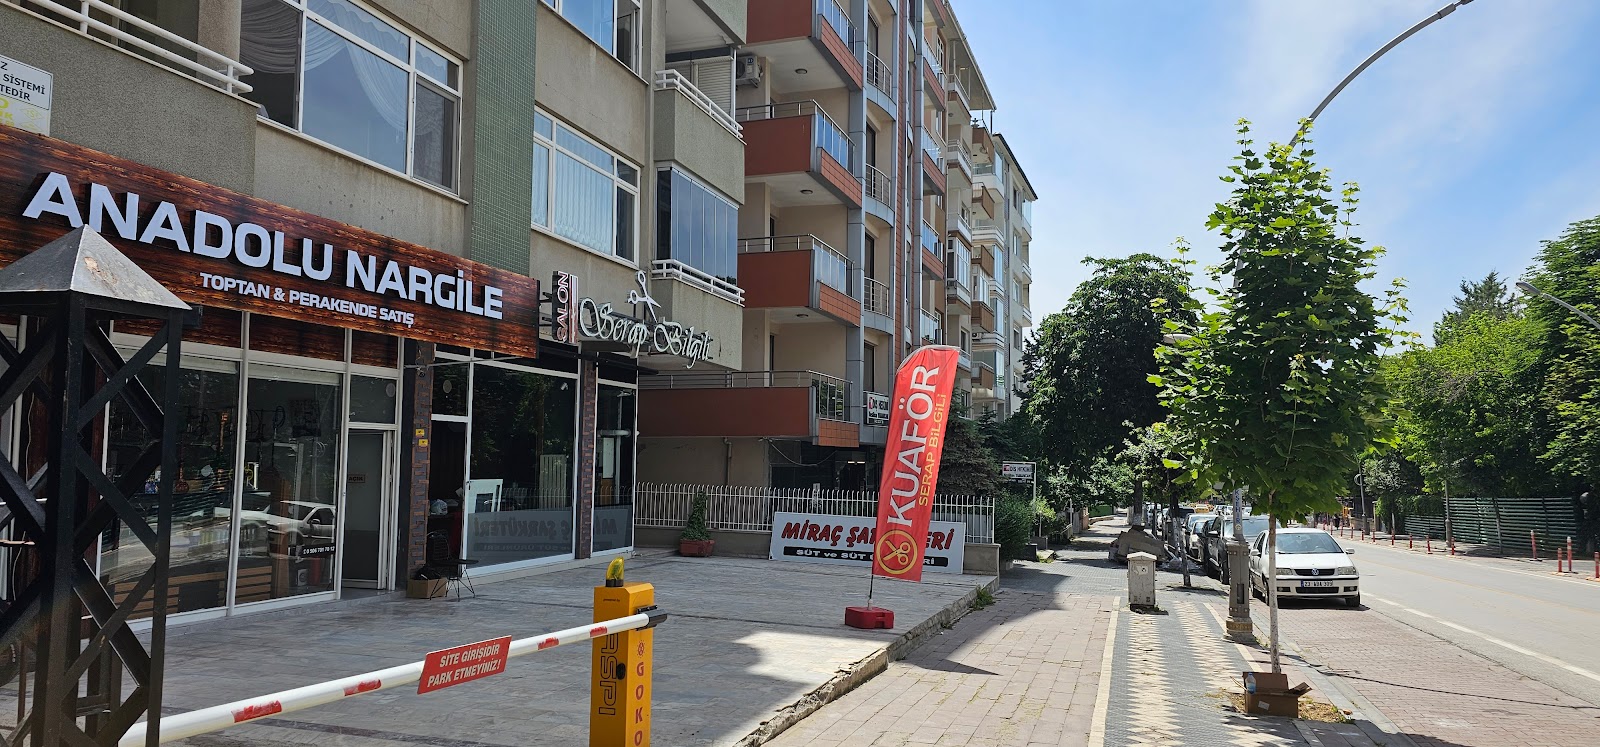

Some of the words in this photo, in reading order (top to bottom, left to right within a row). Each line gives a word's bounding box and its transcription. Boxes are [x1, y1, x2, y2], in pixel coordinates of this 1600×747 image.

[0, 84, 31, 101] TEDİR
[2, 73, 46, 95] SİSTEMİ
[22, 171, 333, 281] ANADOLU
[346, 249, 504, 319] NARGİLE
[200, 272, 269, 299] TOPTAN
[273, 287, 285, 302] &
[289, 290, 377, 319] PERAKENDE
[379, 307, 415, 328] SATIŞ
[557, 271, 569, 342] SALON
[580, 297, 650, 359] Serap
[653, 316, 712, 369] Bilgili
[887, 364, 940, 528] KUAFÖR
[919, 451, 936, 506] SERAP
[781, 520, 844, 547] MİRAÇ
[796, 549, 819, 557] SÜT
[841, 551, 867, 560] SÜT
[427, 671, 453, 688] PARK
[453, 658, 502, 680] ETMEYİNİZ!
[440, 652, 461, 668] SİTE
[461, 642, 500, 662] GİRİŞİDİR
